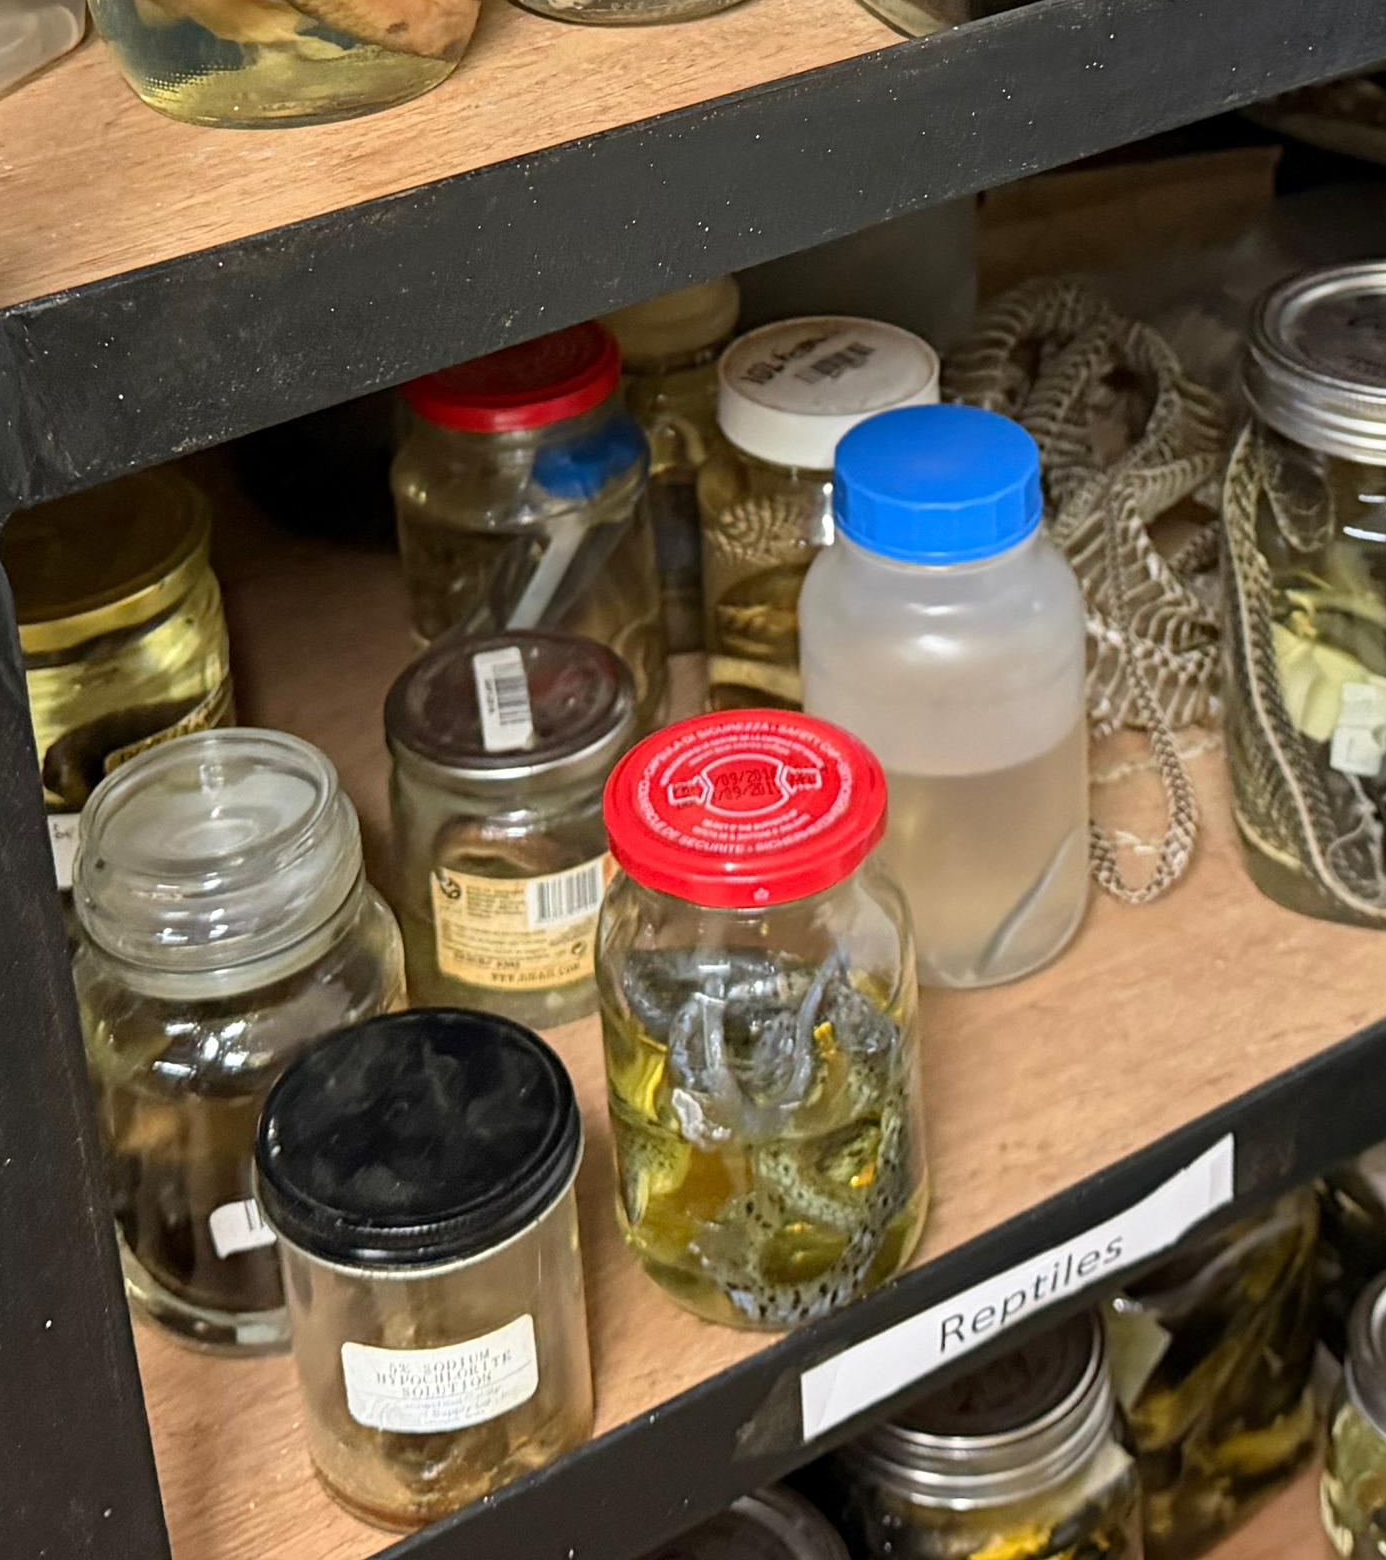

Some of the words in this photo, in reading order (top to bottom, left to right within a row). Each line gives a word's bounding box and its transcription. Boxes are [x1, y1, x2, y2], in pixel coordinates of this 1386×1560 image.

[938, 1234, 1124, 1353] Reptiles
[376, 1349, 512, 1387] HYPOCHLORITE
[423, 1348, 490, 1376] SODIUM
[402, 1371, 492, 1398] SOLUTION
